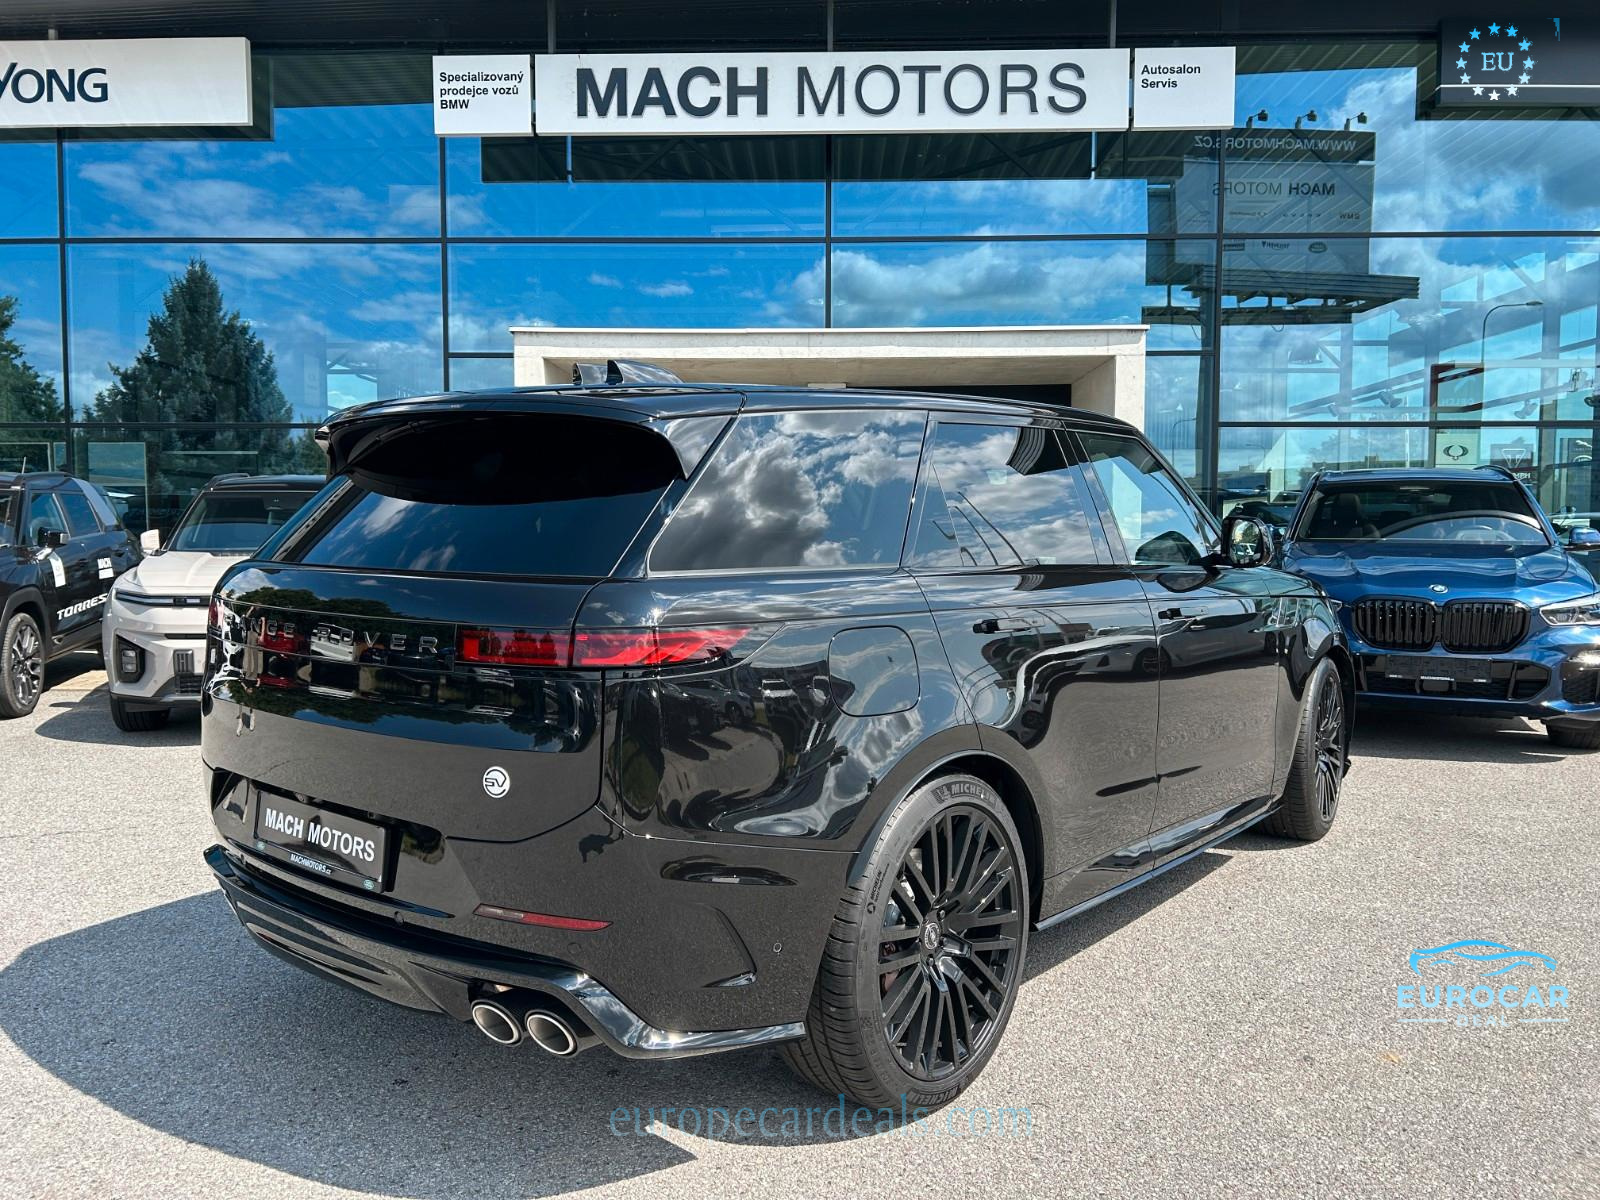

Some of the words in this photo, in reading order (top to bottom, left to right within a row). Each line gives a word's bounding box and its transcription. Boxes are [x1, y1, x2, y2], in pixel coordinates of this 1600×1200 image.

[1141, 64, 1201, 75] Autosalon
[439, 71, 524, 84] Specializovaný
[1141, 78, 1178, 88] Servis
[440, 86, 489, 98] prodejce
[492, 85, 519, 95] vozů
[577, 67, 768, 117] MACH
[797, 63, 1087, 116] MOTORS
[440, 99, 470, 109] BMW
[56, 593, 108, 620] TORRES
[316, 626, 438, 654] ROVER
[264, 807, 305, 840] MACH
[307, 822, 375, 862] MOTORS
